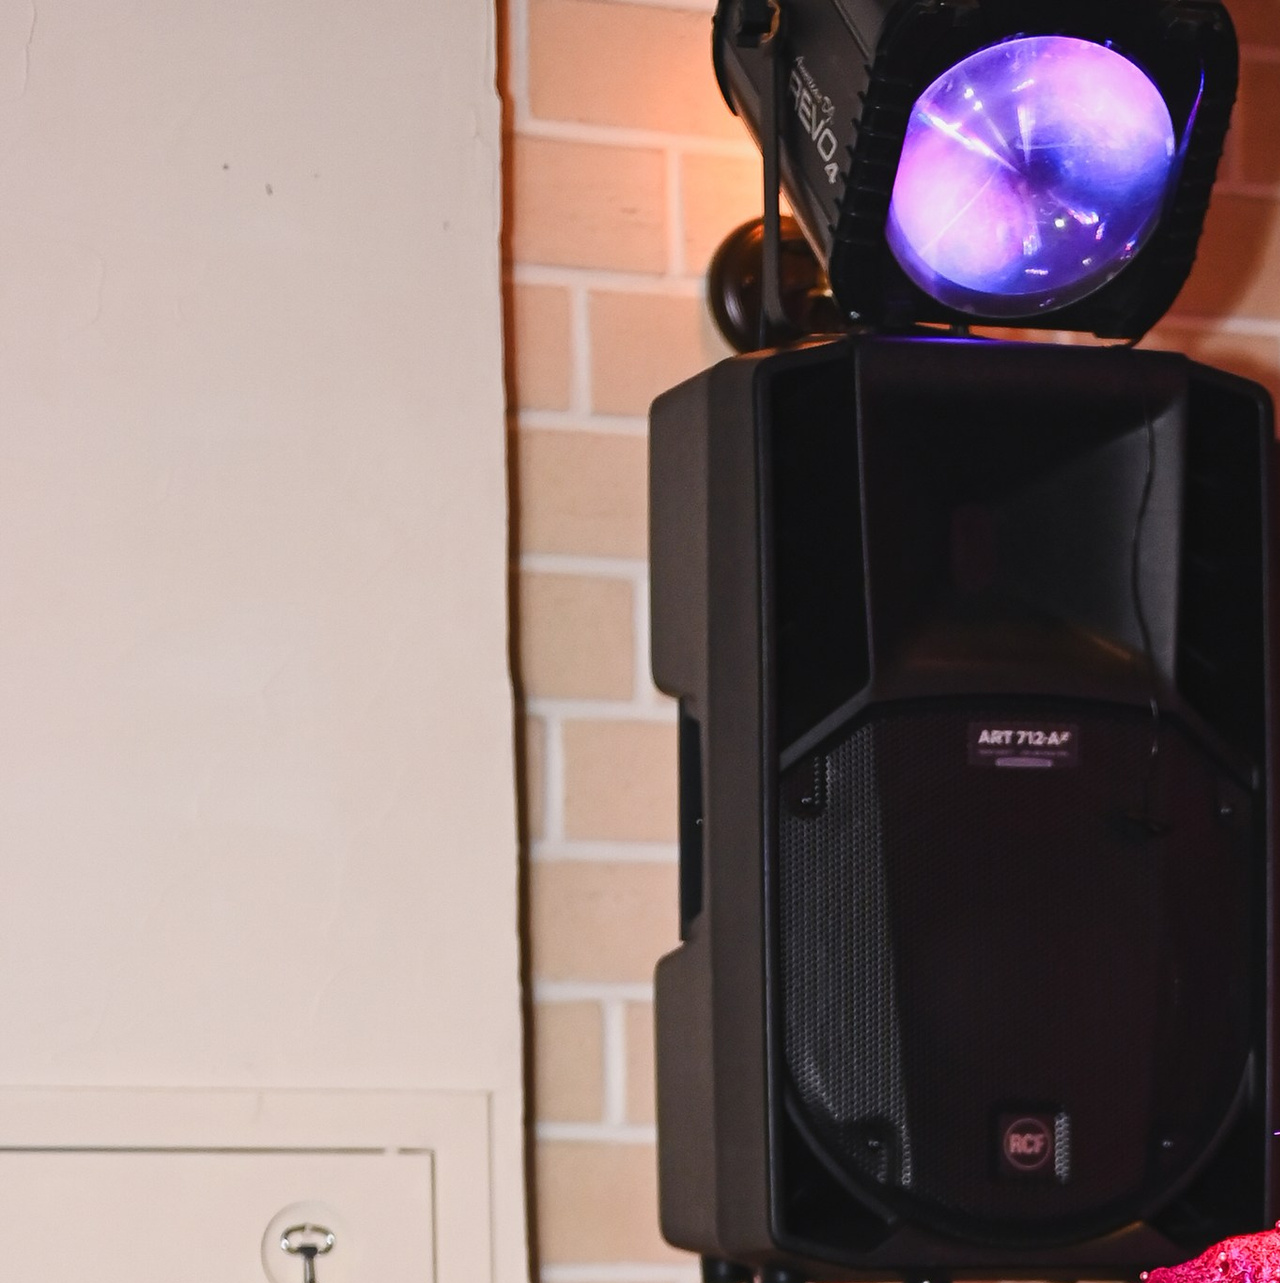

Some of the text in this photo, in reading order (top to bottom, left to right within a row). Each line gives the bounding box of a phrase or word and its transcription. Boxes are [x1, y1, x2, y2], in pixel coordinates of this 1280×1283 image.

[790, 69, 838, 162] REVO
[978, 729, 1013, 745] ART
[1009, 1133, 1044, 1154] RCF
